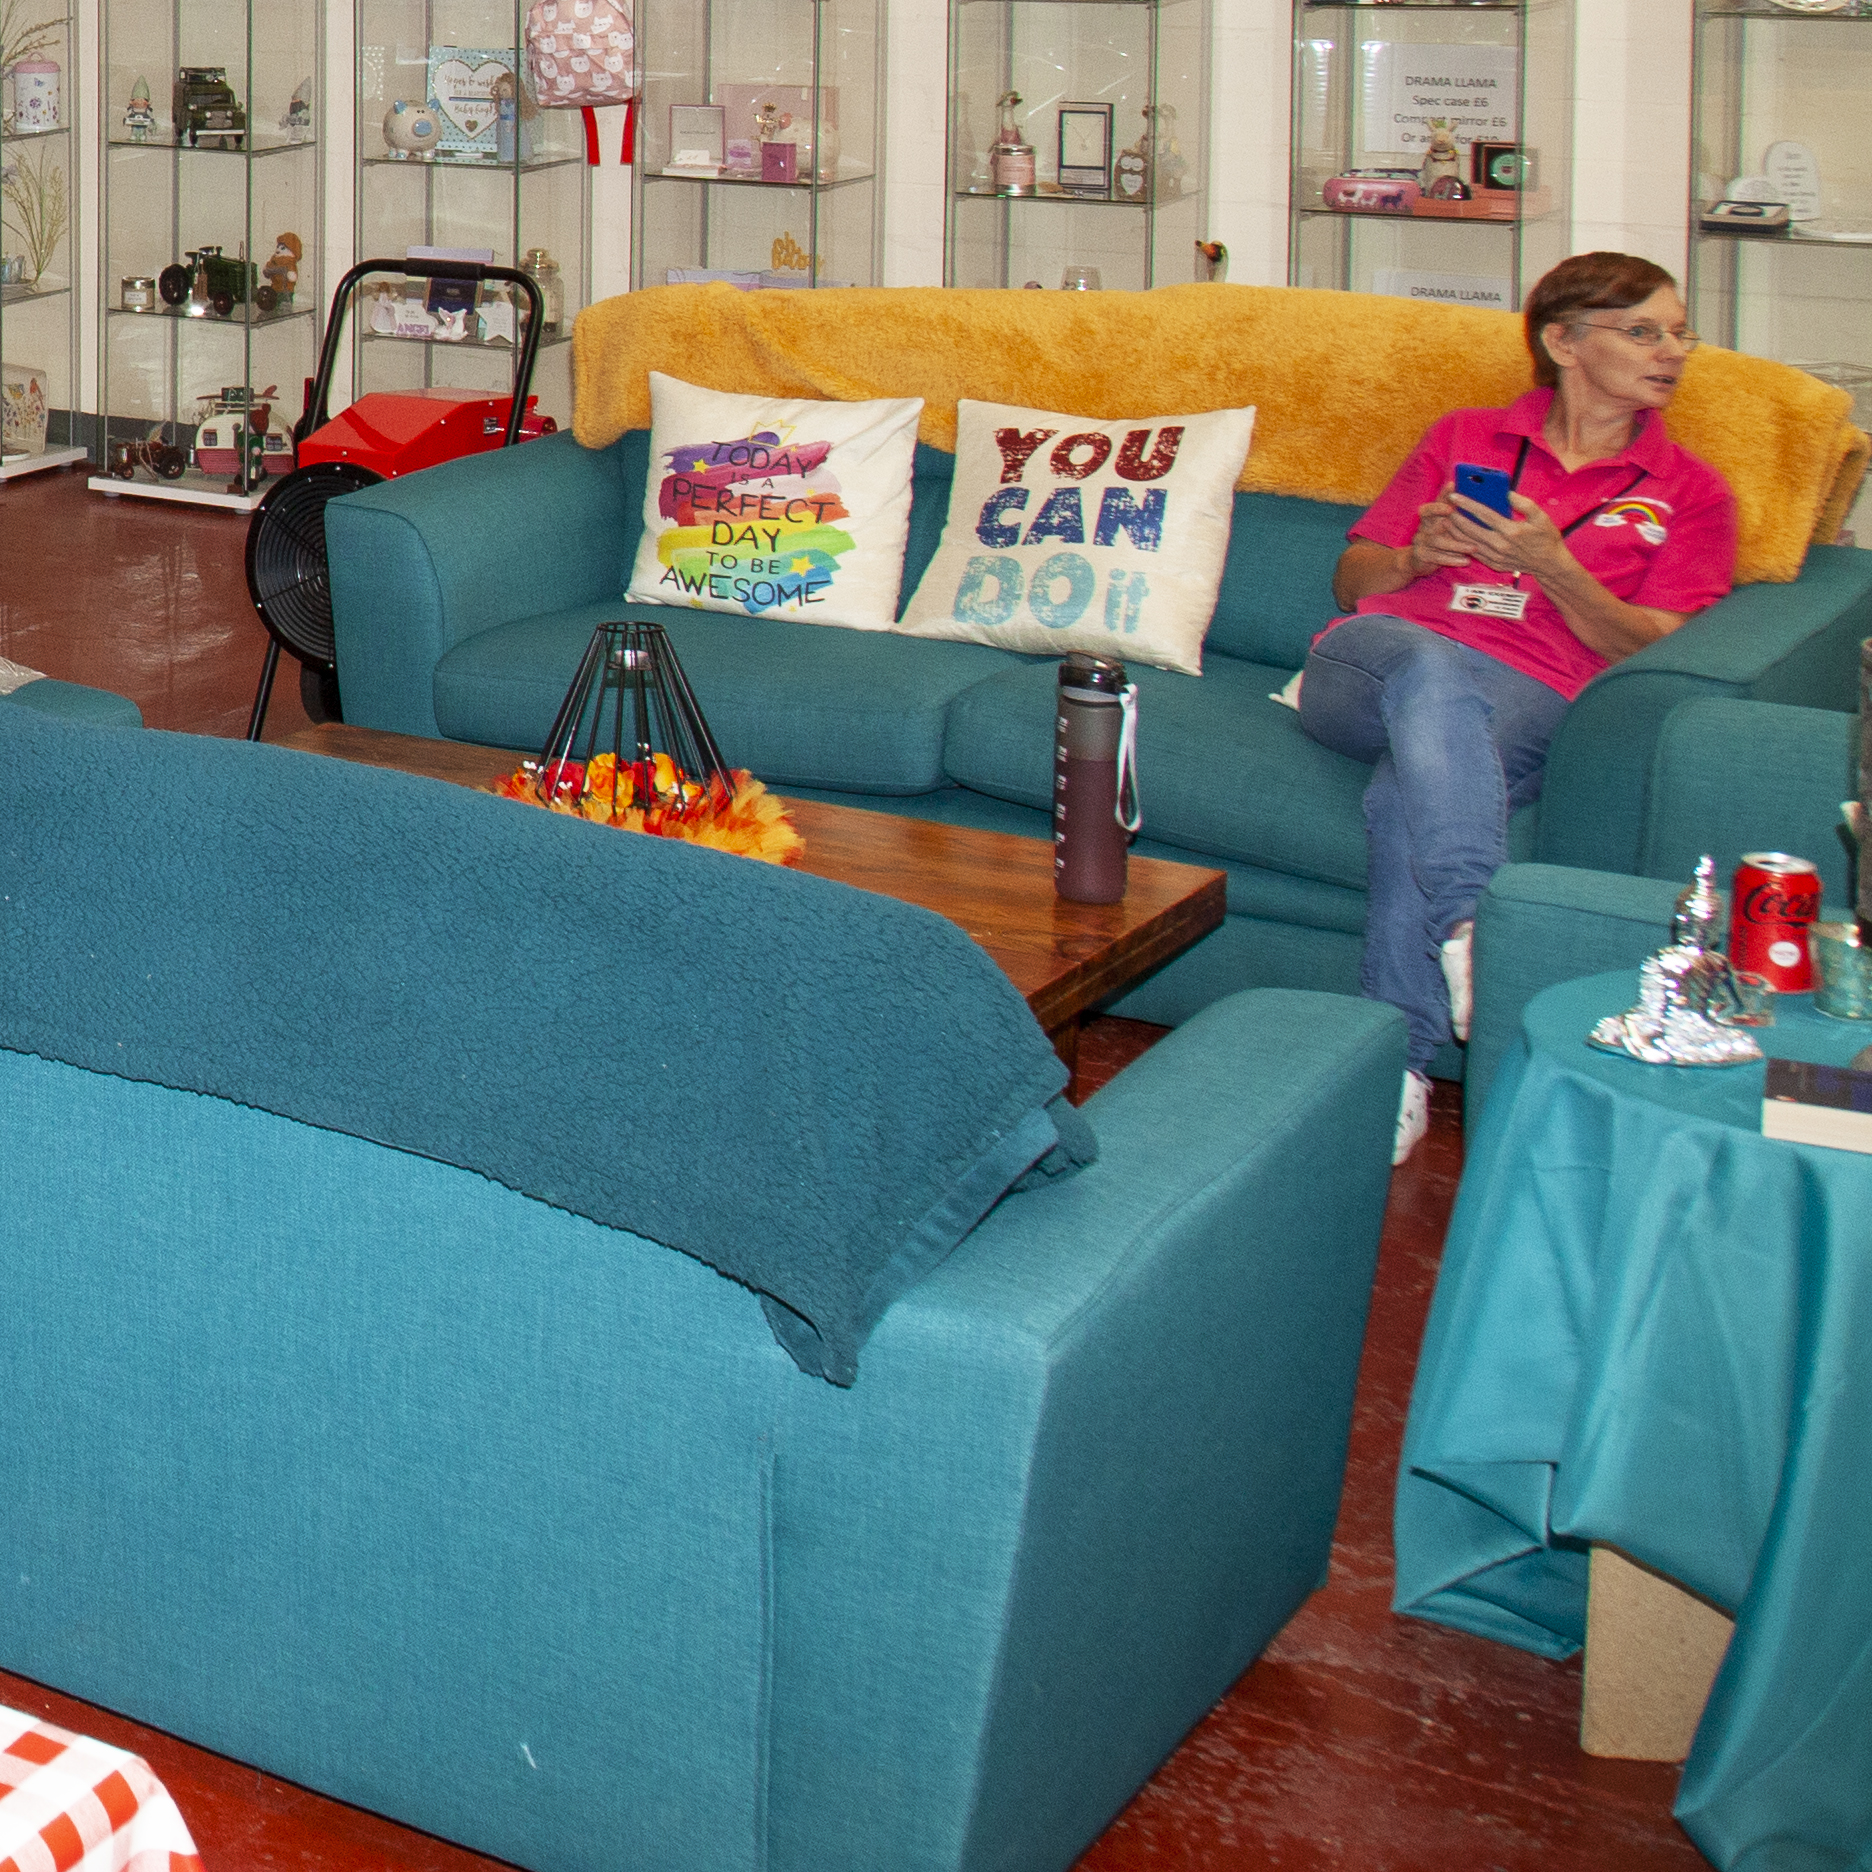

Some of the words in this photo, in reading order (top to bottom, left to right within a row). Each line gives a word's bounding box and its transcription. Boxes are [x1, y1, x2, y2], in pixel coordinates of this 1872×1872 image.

[1404, 75, 1452, 87] DRAMA
[1455, 76, 1498, 89] LLAMA
[1412, 94, 1442, 107] Spec
[1443, 98, 1471, 107] case
[1410, 285, 1456, 300] DRAMA
[1457, 288, 1502, 304] LLAMA
[711, 440, 813, 479] TODAY
[992, 426, 1186, 485] YOU
[730, 471, 750, 486] IS
[761, 477, 775, 489] A
[672, 477, 836, 524] PERFECT
[711, 519, 781, 553] DAY
[974, 486, 1168, 553] CAN
[706, 550, 738, 570] TO
[750, 557, 781, 575] BE
[659, 564, 831, 607] AWESOME
[951, 552, 1097, 629] DO
[1103, 568, 1151, 634] it
